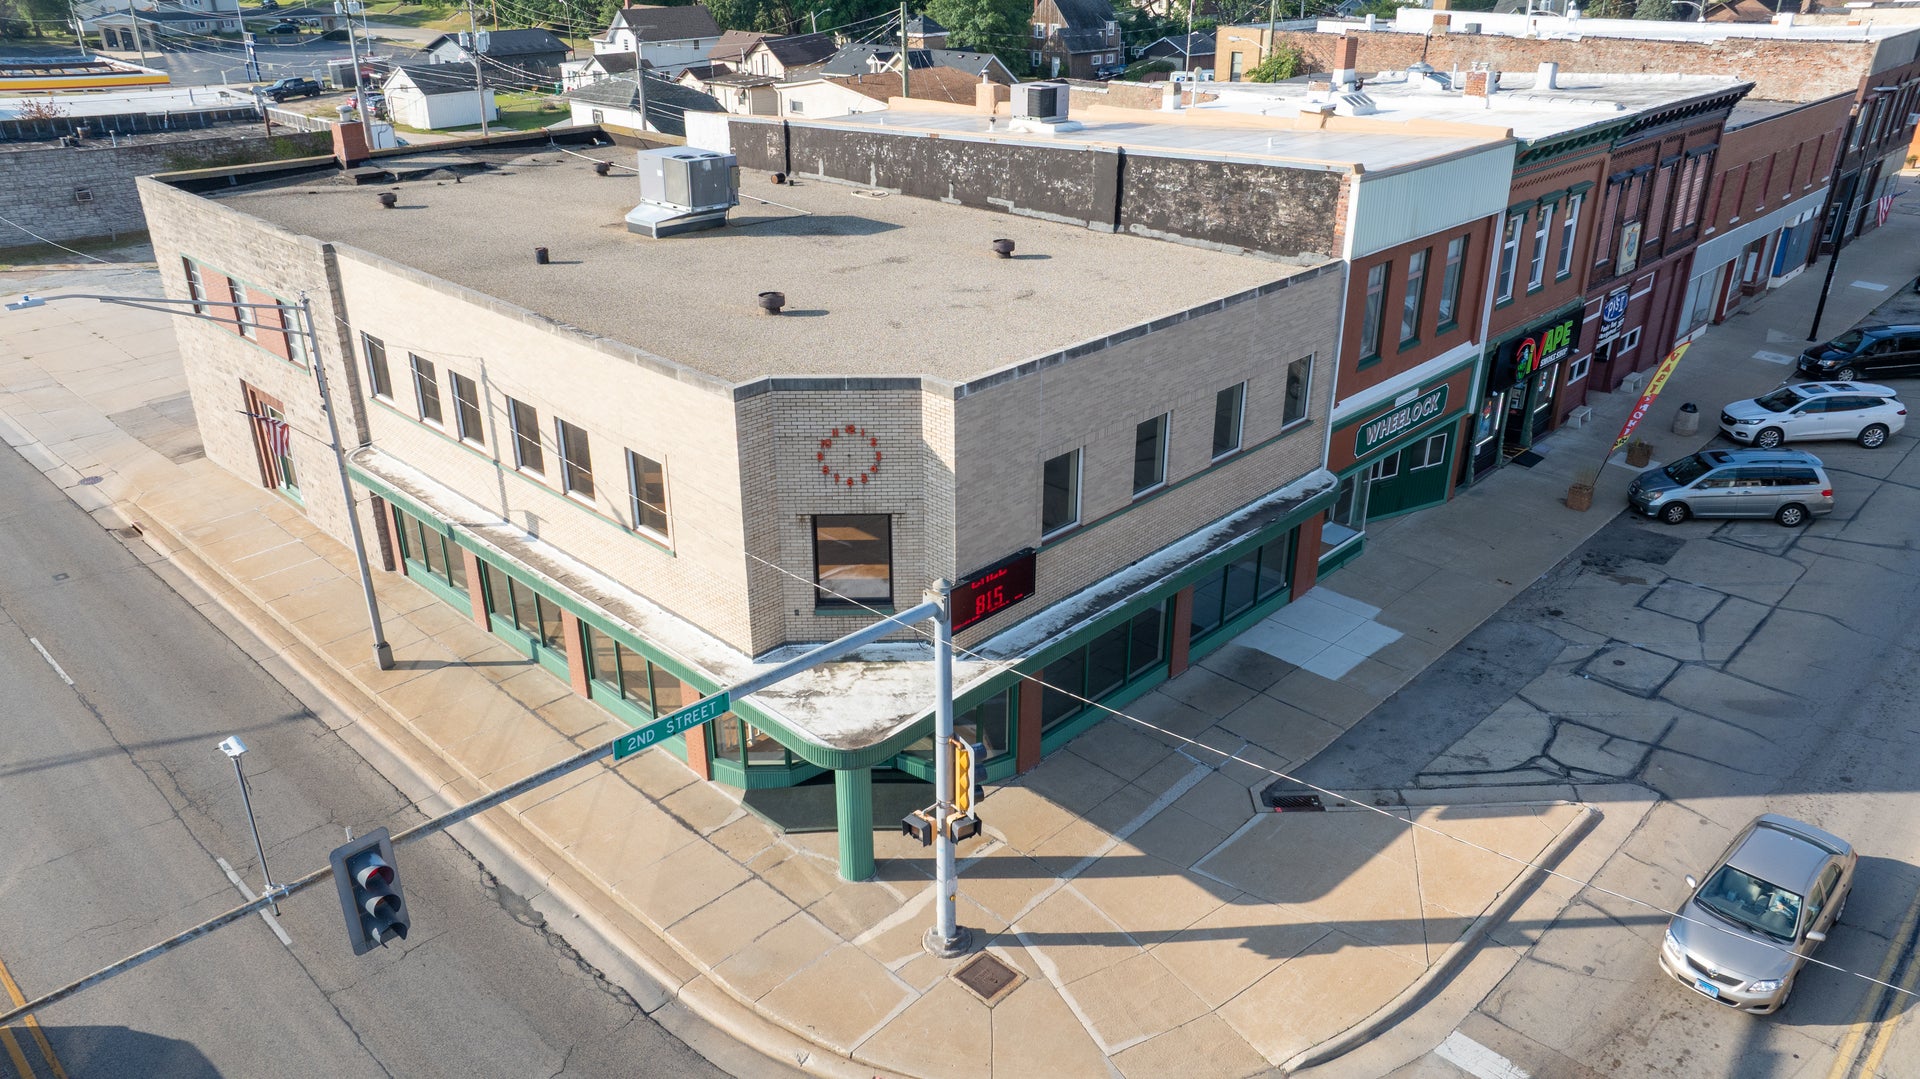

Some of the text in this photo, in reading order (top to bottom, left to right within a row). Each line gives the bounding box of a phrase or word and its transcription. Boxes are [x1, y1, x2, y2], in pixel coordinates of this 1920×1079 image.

[1540, 347, 1568, 368] SMOKE SHOP
[1366, 391, 1442, 446] WHEELOCK
[975, 584, 1004, 615] 815
[627, 701, 717, 751] 2ND STREET
